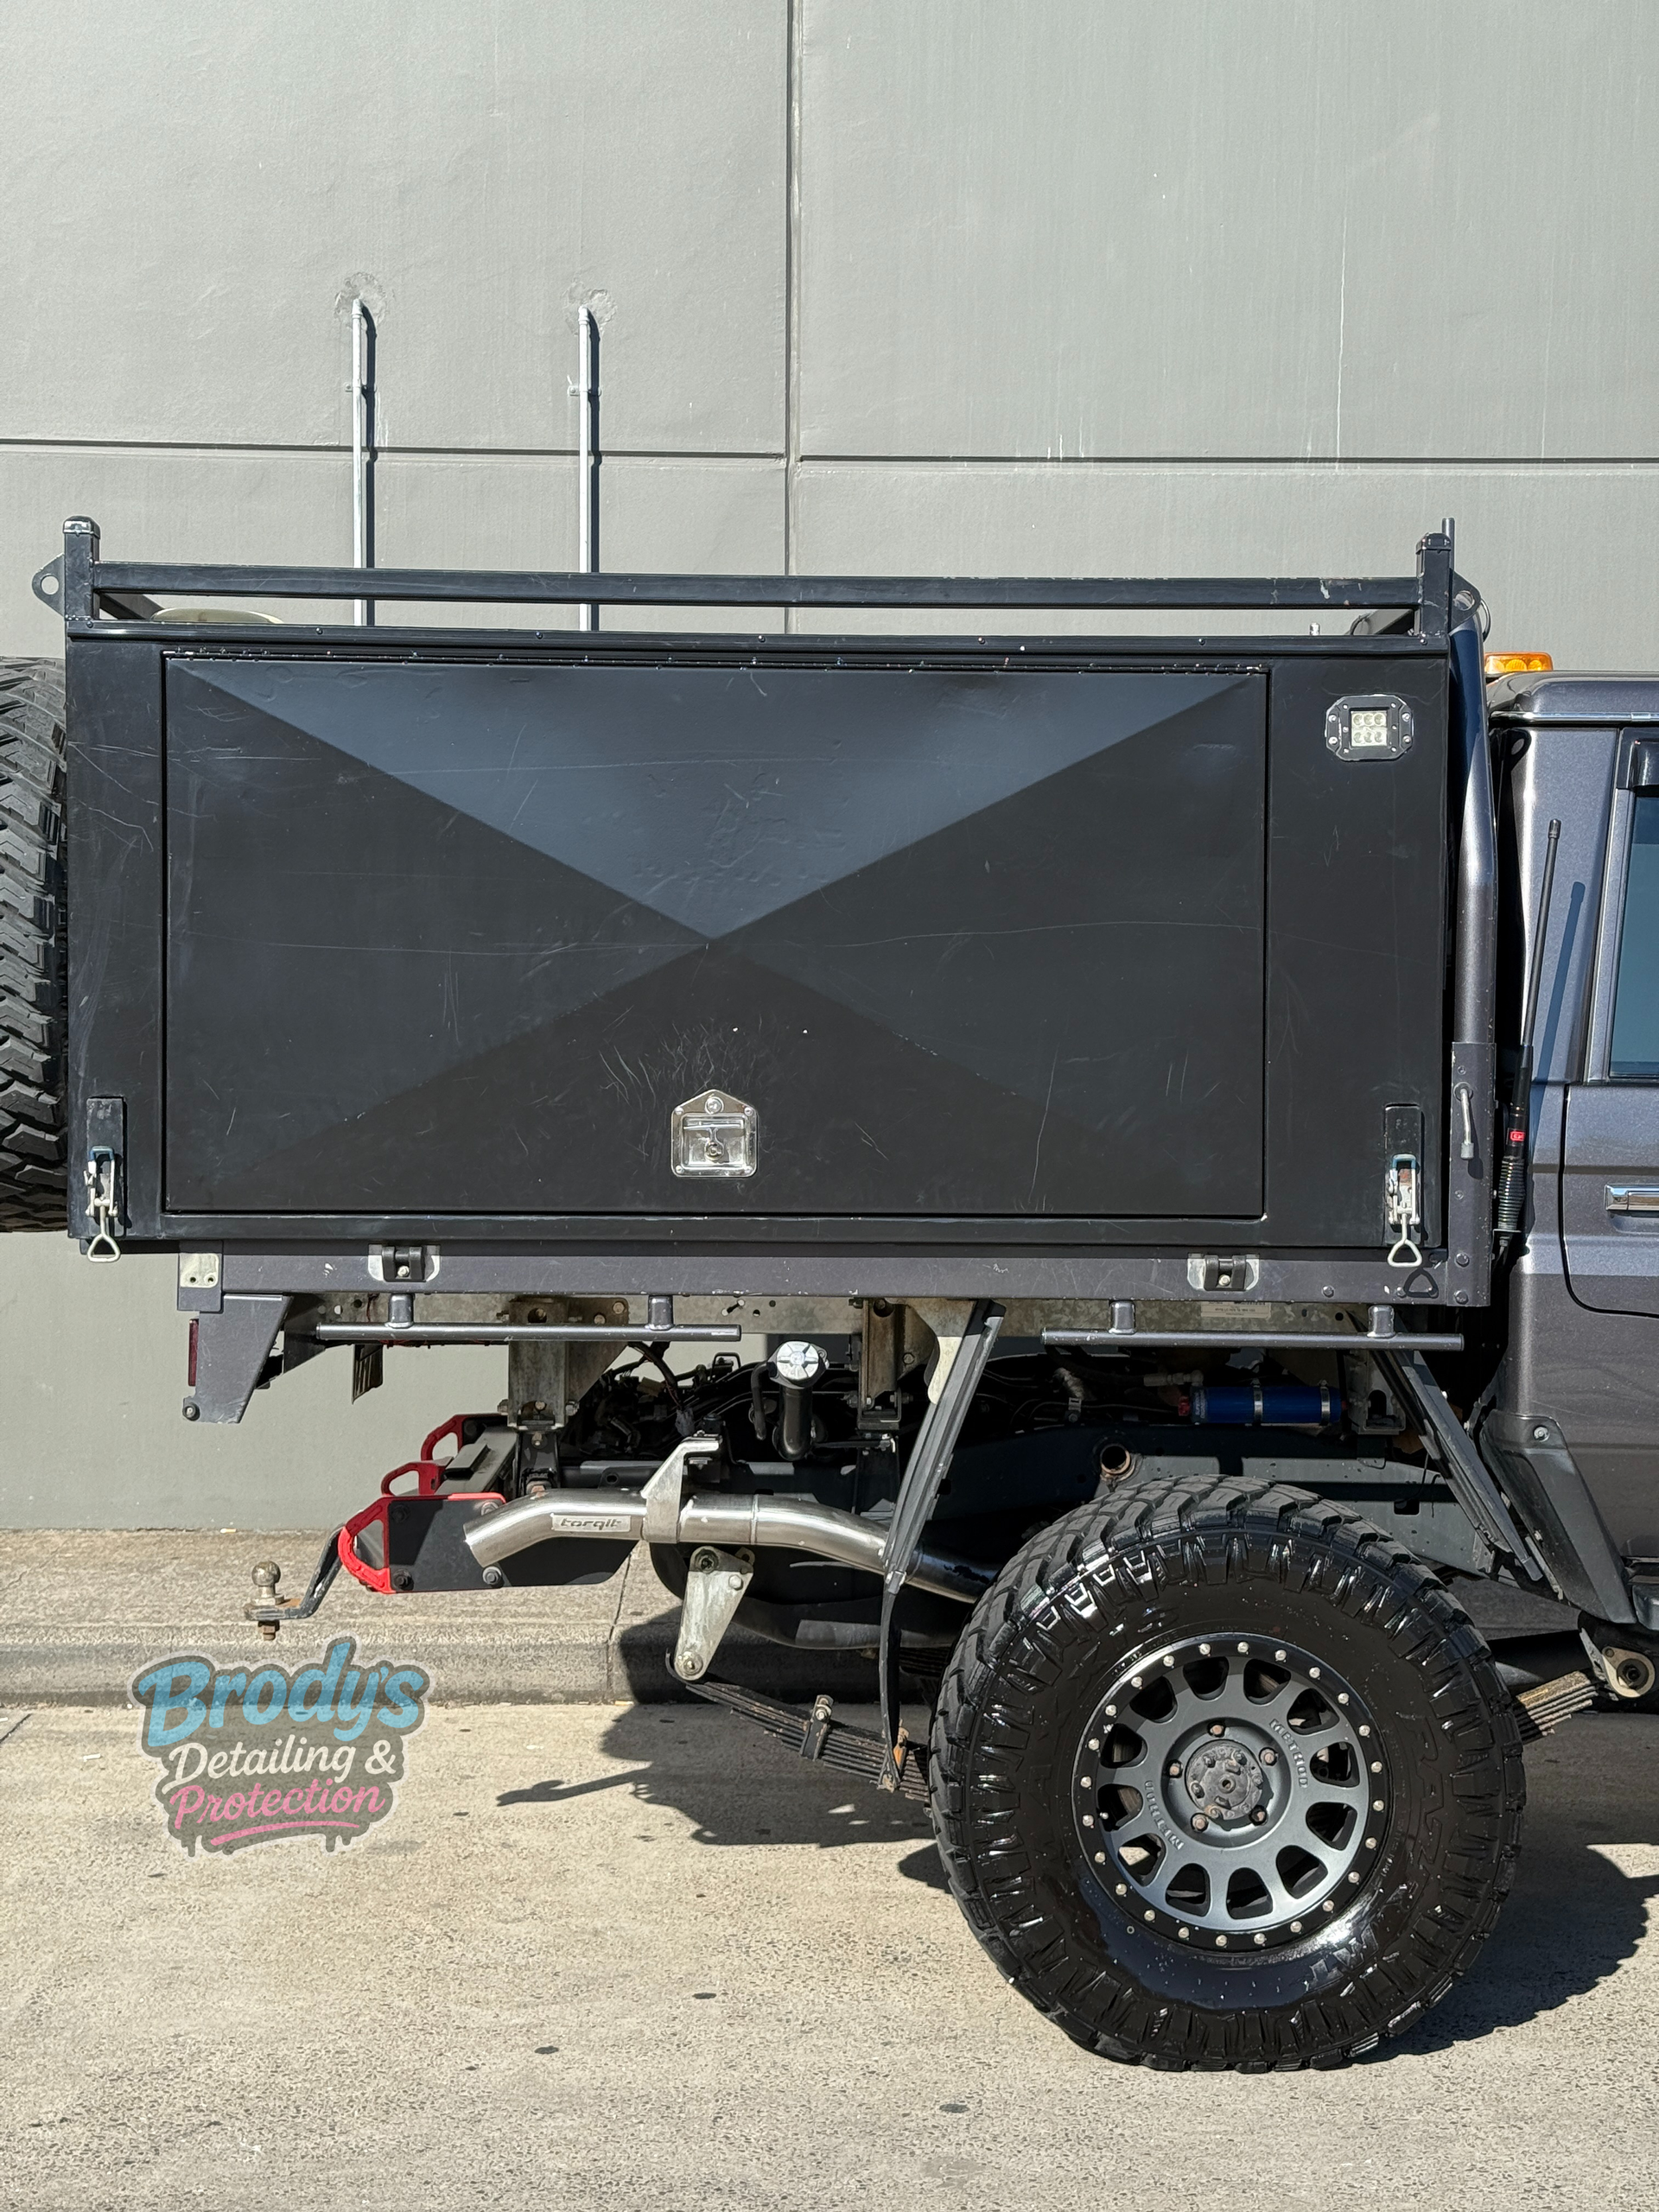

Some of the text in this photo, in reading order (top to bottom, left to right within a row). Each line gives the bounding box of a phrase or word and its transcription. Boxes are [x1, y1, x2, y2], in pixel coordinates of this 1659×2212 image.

[560, 1517, 622, 1531] torqit
[1269, 1719, 1309, 1788] METHOD
[1145, 1781, 1185, 1850] METHOD
